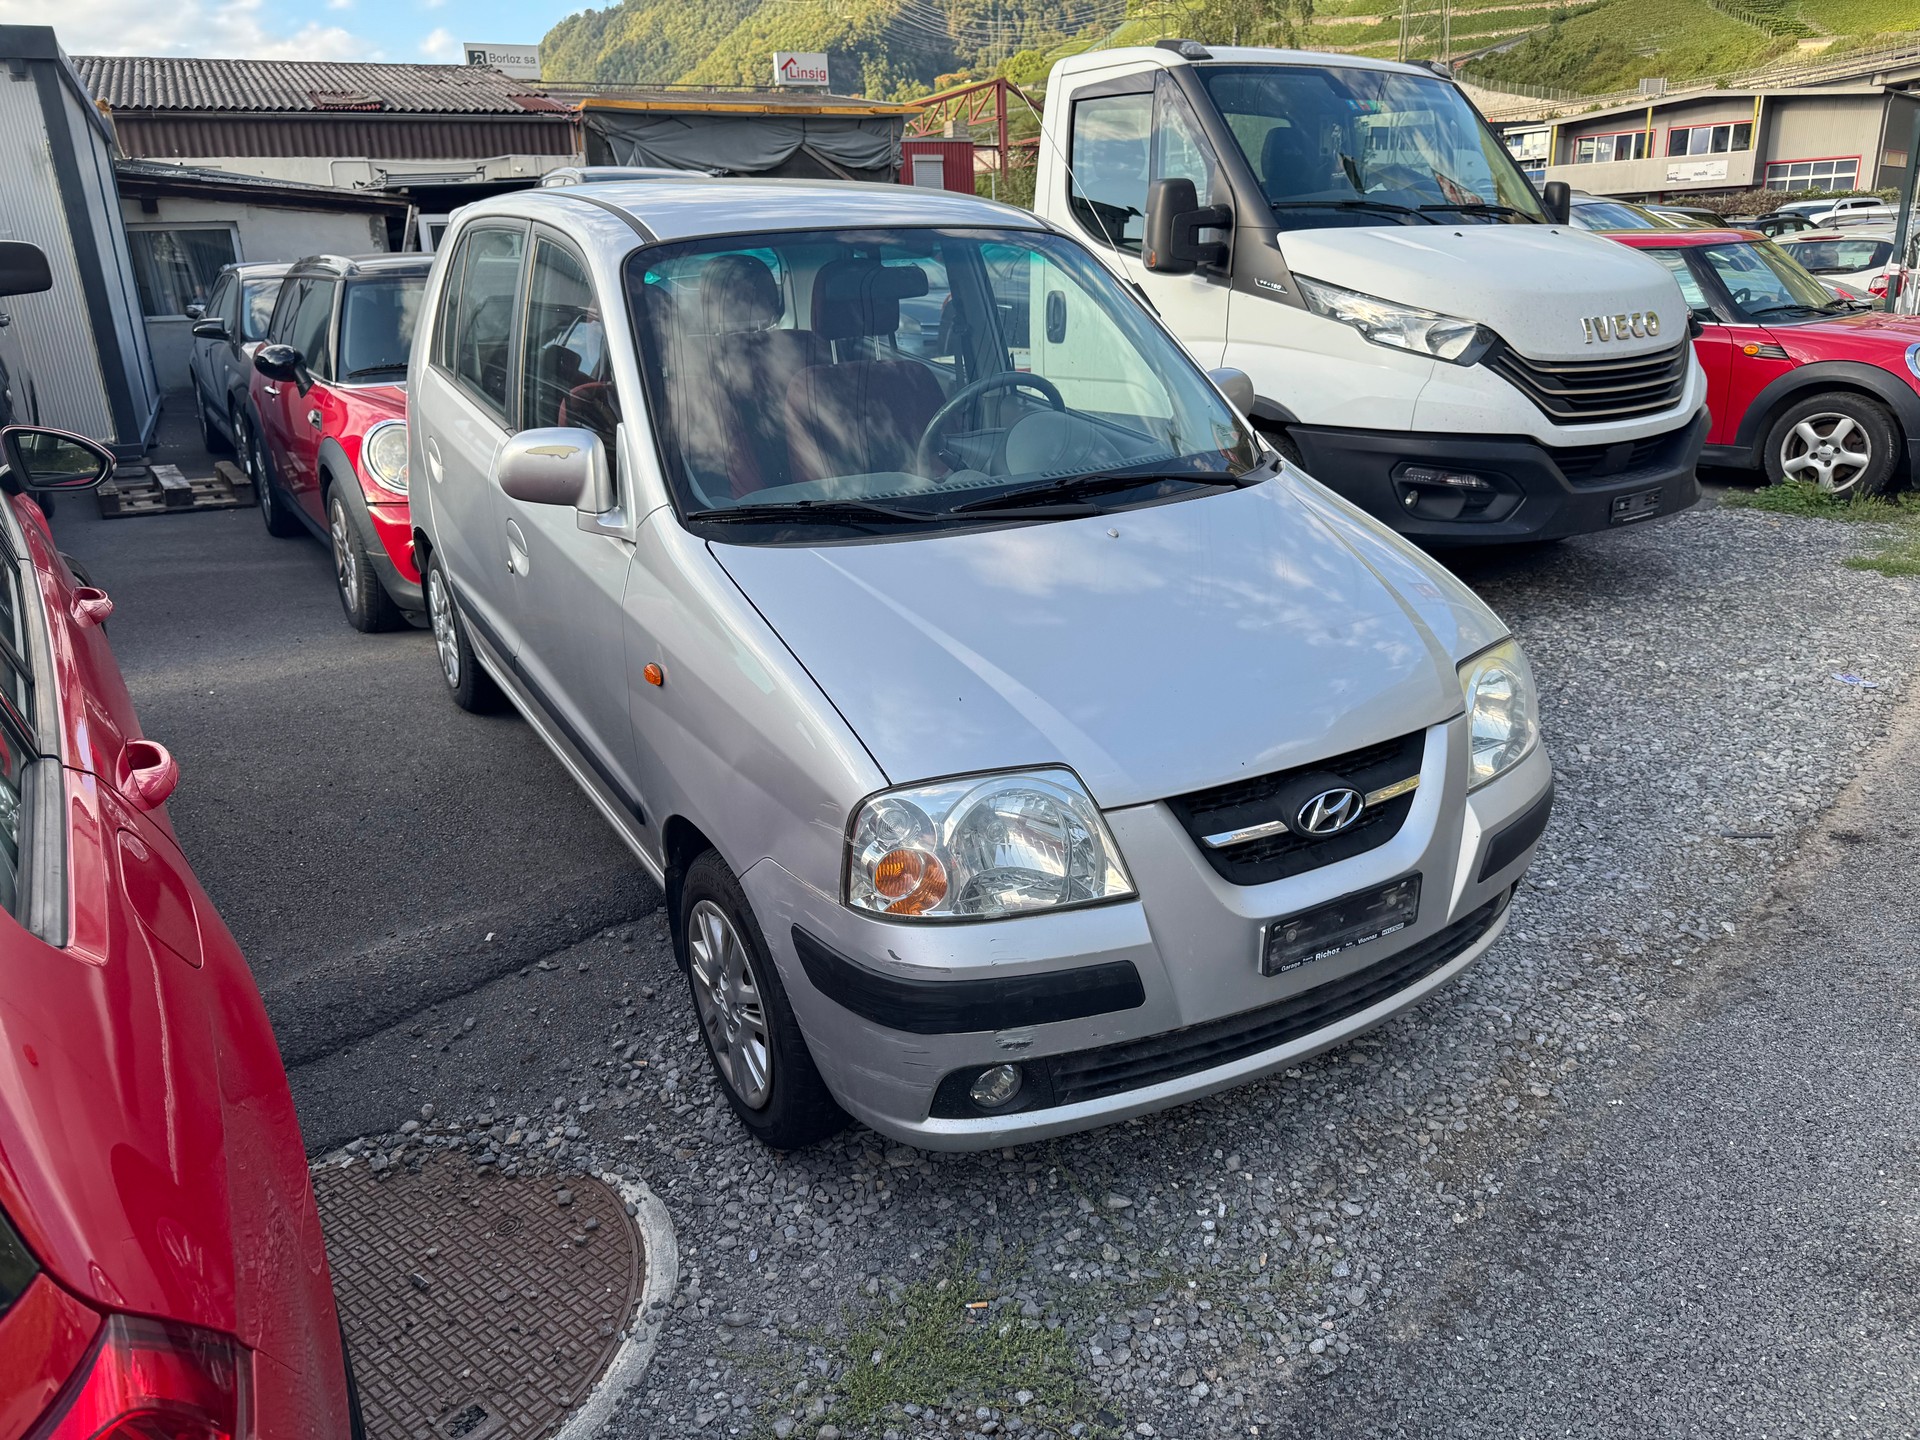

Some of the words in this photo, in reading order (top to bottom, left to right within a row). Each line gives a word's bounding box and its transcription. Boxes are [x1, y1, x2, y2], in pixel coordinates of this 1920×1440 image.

[488, 53, 521, 64] Borloz
[524, 56, 536, 64] sa
[789, 66, 827, 82] Linsig
[1580, 311, 1660, 344] IVECO
[1281, 961, 1301, 972] Garage
[1315, 947, 1341, 961] Richoz
